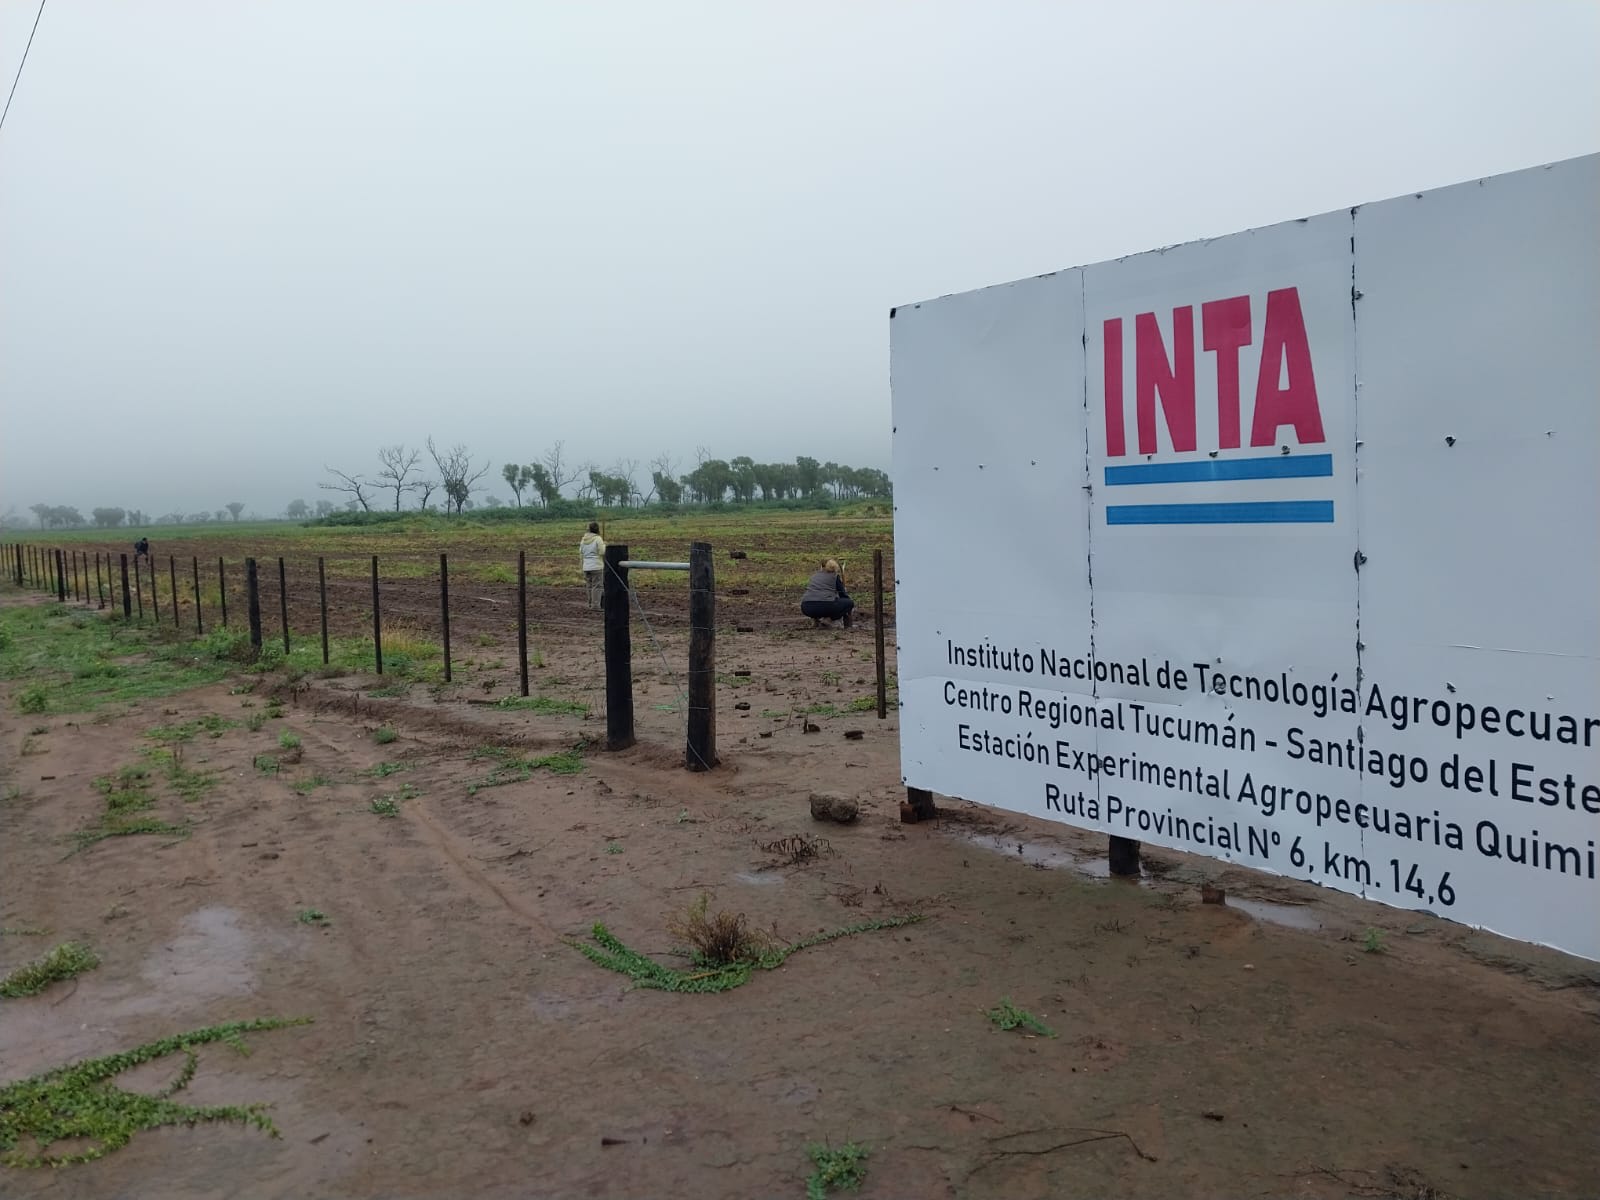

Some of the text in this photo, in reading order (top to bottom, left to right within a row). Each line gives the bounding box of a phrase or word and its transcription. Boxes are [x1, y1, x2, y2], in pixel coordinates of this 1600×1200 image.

[1103, 286, 1326, 457] INTA
[944, 680, 1012, 715] Centro
[1018, 690, 1125, 731] Regional
[1129, 703, 1256, 752] Tucumán
[1286, 727, 1428, 788] Santiago
[1440, 754, 1499, 797] del
[1511, 762, 1600, 814] Este
[947, 639, 1600, 747] Instituto Nacional de Tecnología Agropecuar
[958, 724, 1595, 879] Estación Experimental Agropecuaria Quimi
[1045, 783, 1100, 821] Ruta
[1107, 795, 1241, 852] Provincial
[1290, 835, 1314, 874] 6,
[1324, 841, 1381, 888] km.
[1389, 858, 1456, 907] 14,6
